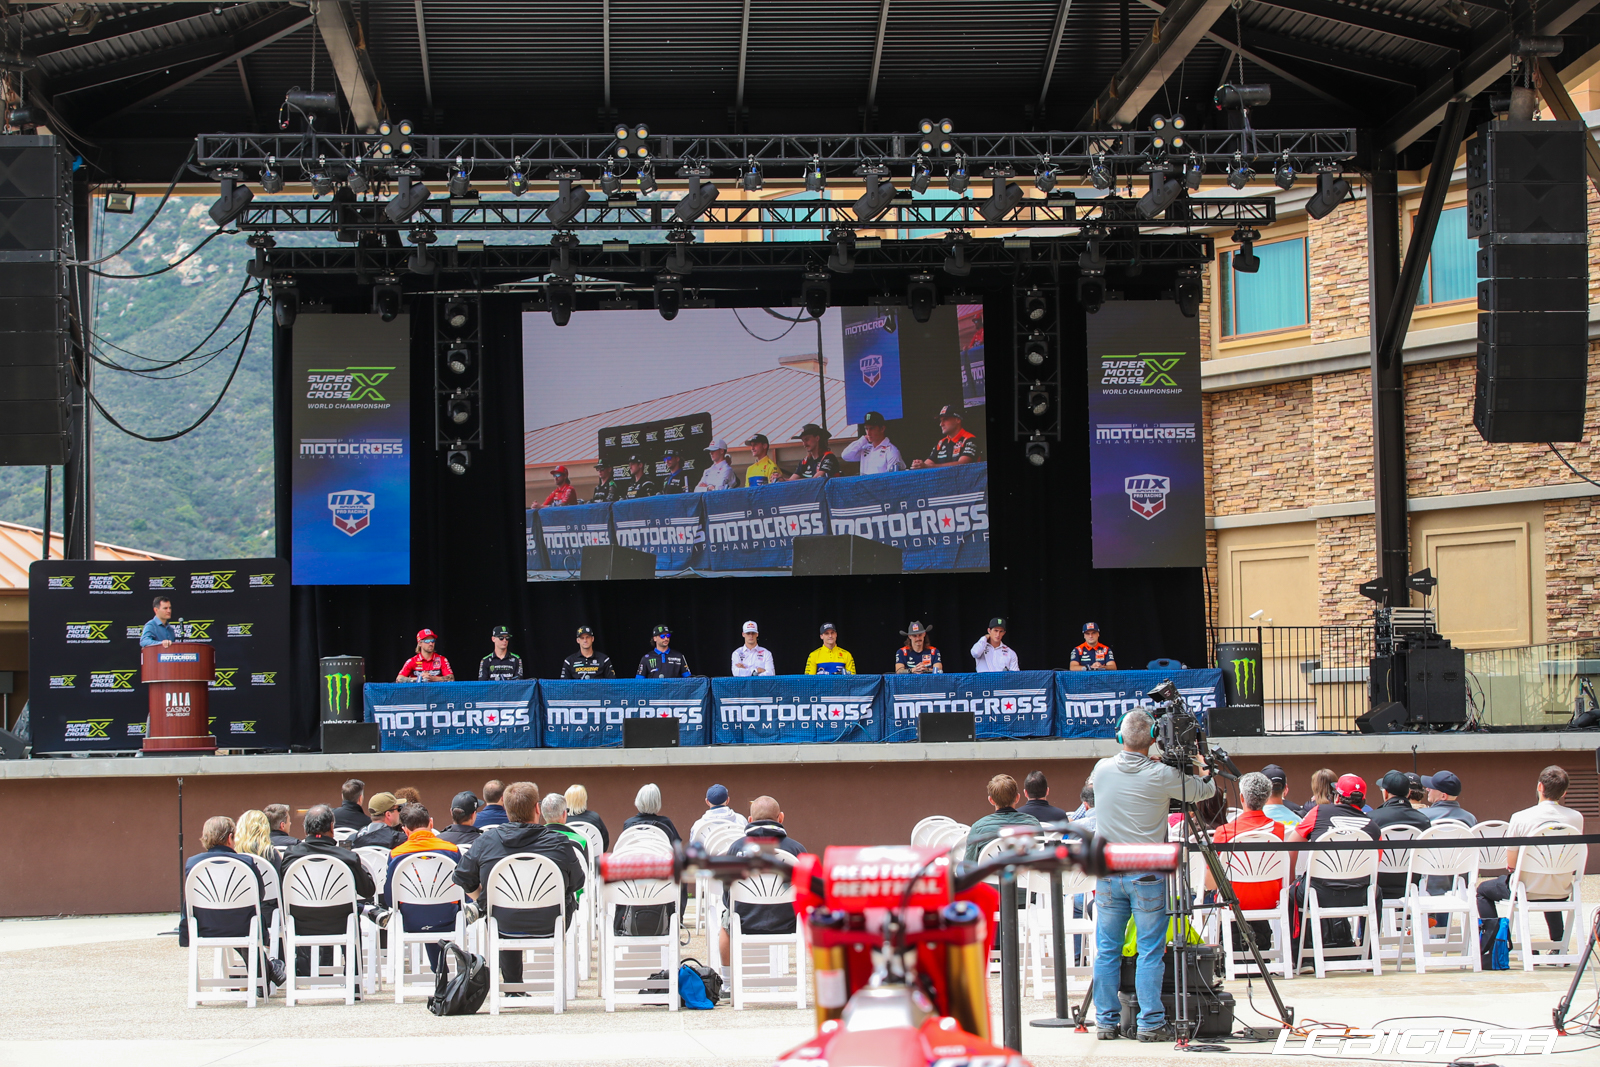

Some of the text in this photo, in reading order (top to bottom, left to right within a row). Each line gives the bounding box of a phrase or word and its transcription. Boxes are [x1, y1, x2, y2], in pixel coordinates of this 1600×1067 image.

[845, 320, 886, 336] MOTOCRO
[1096, 428, 1196, 440] MOTOCROSS
[300, 444, 403, 455] MOTOCROSS
[1127, 478, 1168, 489] MX
[330, 495, 372, 505] MX
[884, 499, 926, 512] PRO
[747, 506, 777, 518] PRO
[708, 513, 824, 544] MOTOCROSS
[831, 504, 989, 540] MOTOCROSS
[543, 531, 610, 548] MOTOCROSS
[616, 524, 705, 546] MOTOCROSS
[166, 692, 190, 706] PALA
[547, 707, 702, 724] MOTOCROSS
[720, 703, 872, 723] MOTOCROSS
[894, 696, 1047, 719] MOTOCROSS
[374, 709, 530, 730] MOTOCROSS
[722, 719, 874, 730] CHAMPIONSHIP
[388, 726, 530, 737] HAMPIONSHIP
[830, 864, 941, 880] RENTHAL
[831, 880, 942, 897] RENTHAL
